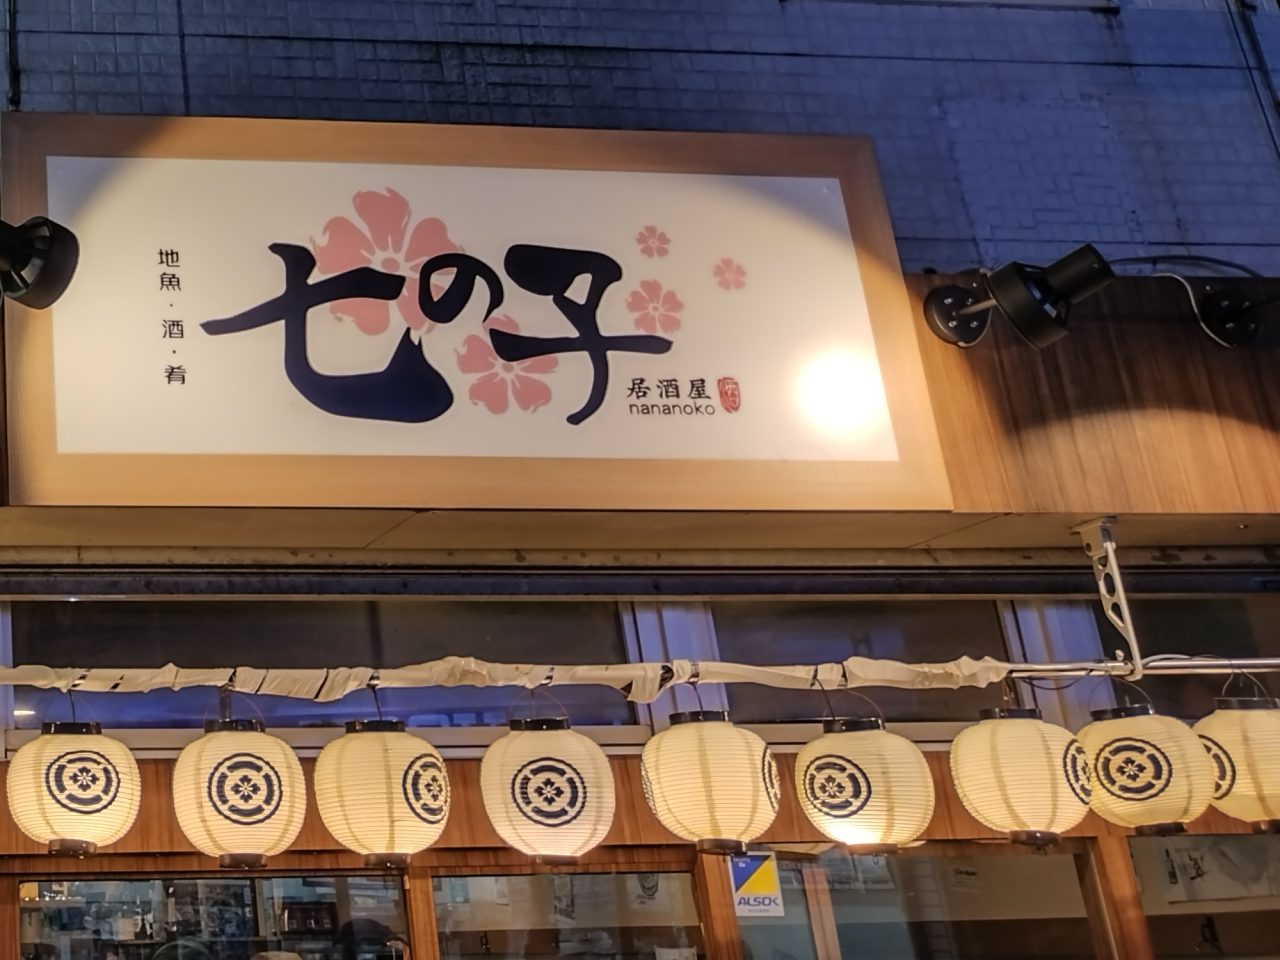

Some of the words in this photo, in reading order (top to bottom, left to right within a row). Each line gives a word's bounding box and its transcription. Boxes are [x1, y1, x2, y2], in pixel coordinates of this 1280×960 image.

[200, 242, 673, 426] 七の子
[626, 377, 712, 400] 居酒屋
[629, 401, 716, 415] nananoko
[737, 896, 780, 907] ALSOK
